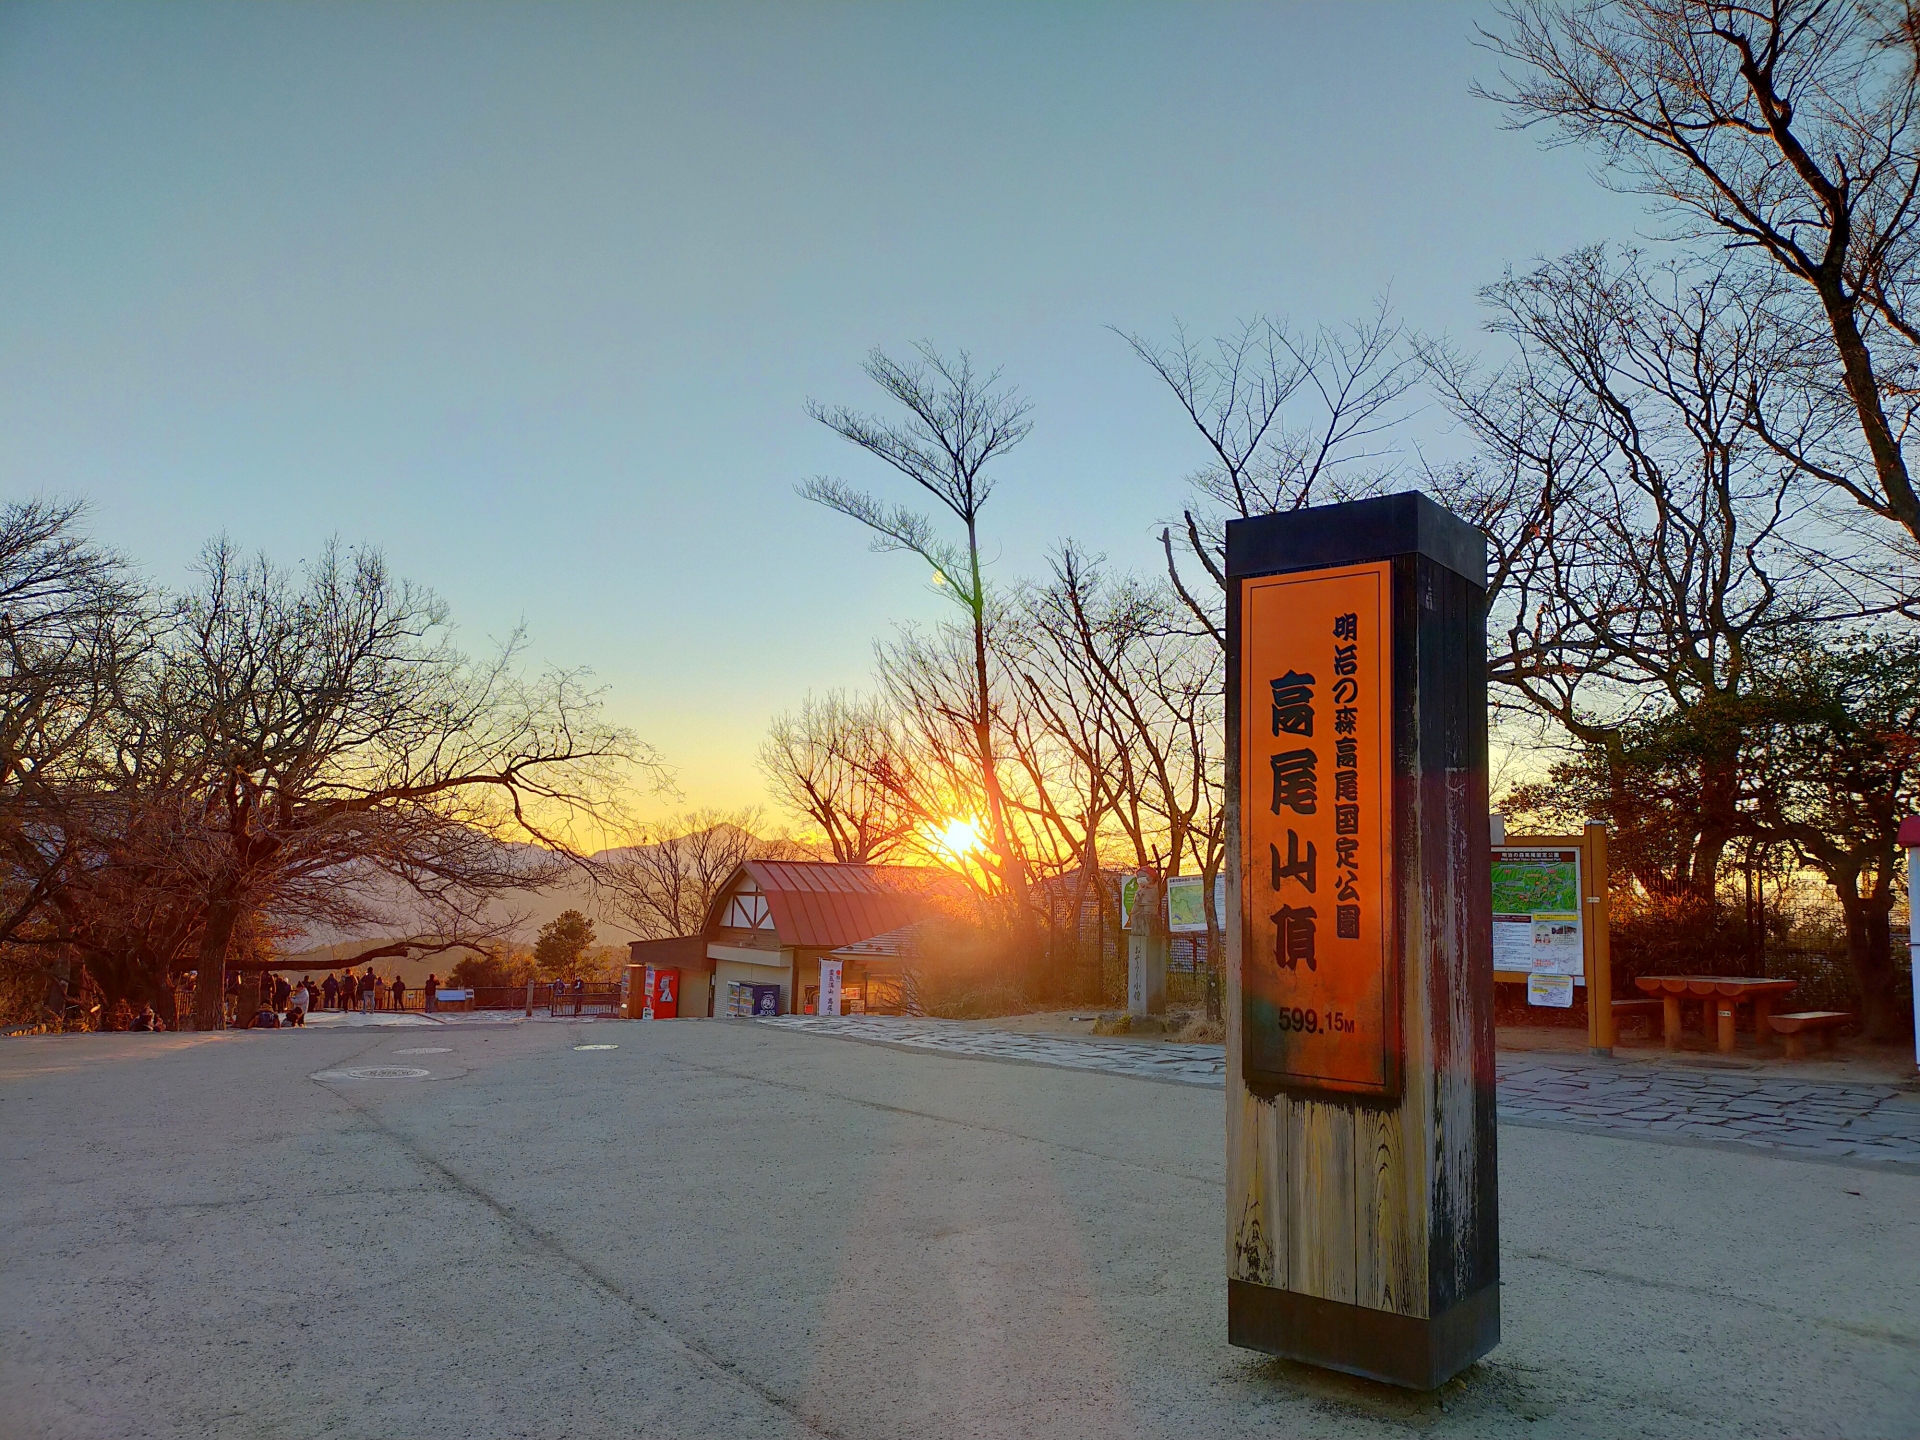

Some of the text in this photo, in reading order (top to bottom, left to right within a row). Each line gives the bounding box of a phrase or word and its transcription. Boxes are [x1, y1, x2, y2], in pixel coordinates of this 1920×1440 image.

[1269, 669, 1318, 972] 高尾山頂
[1332, 612, 1360, 940] 明治の森高尾国定公園
